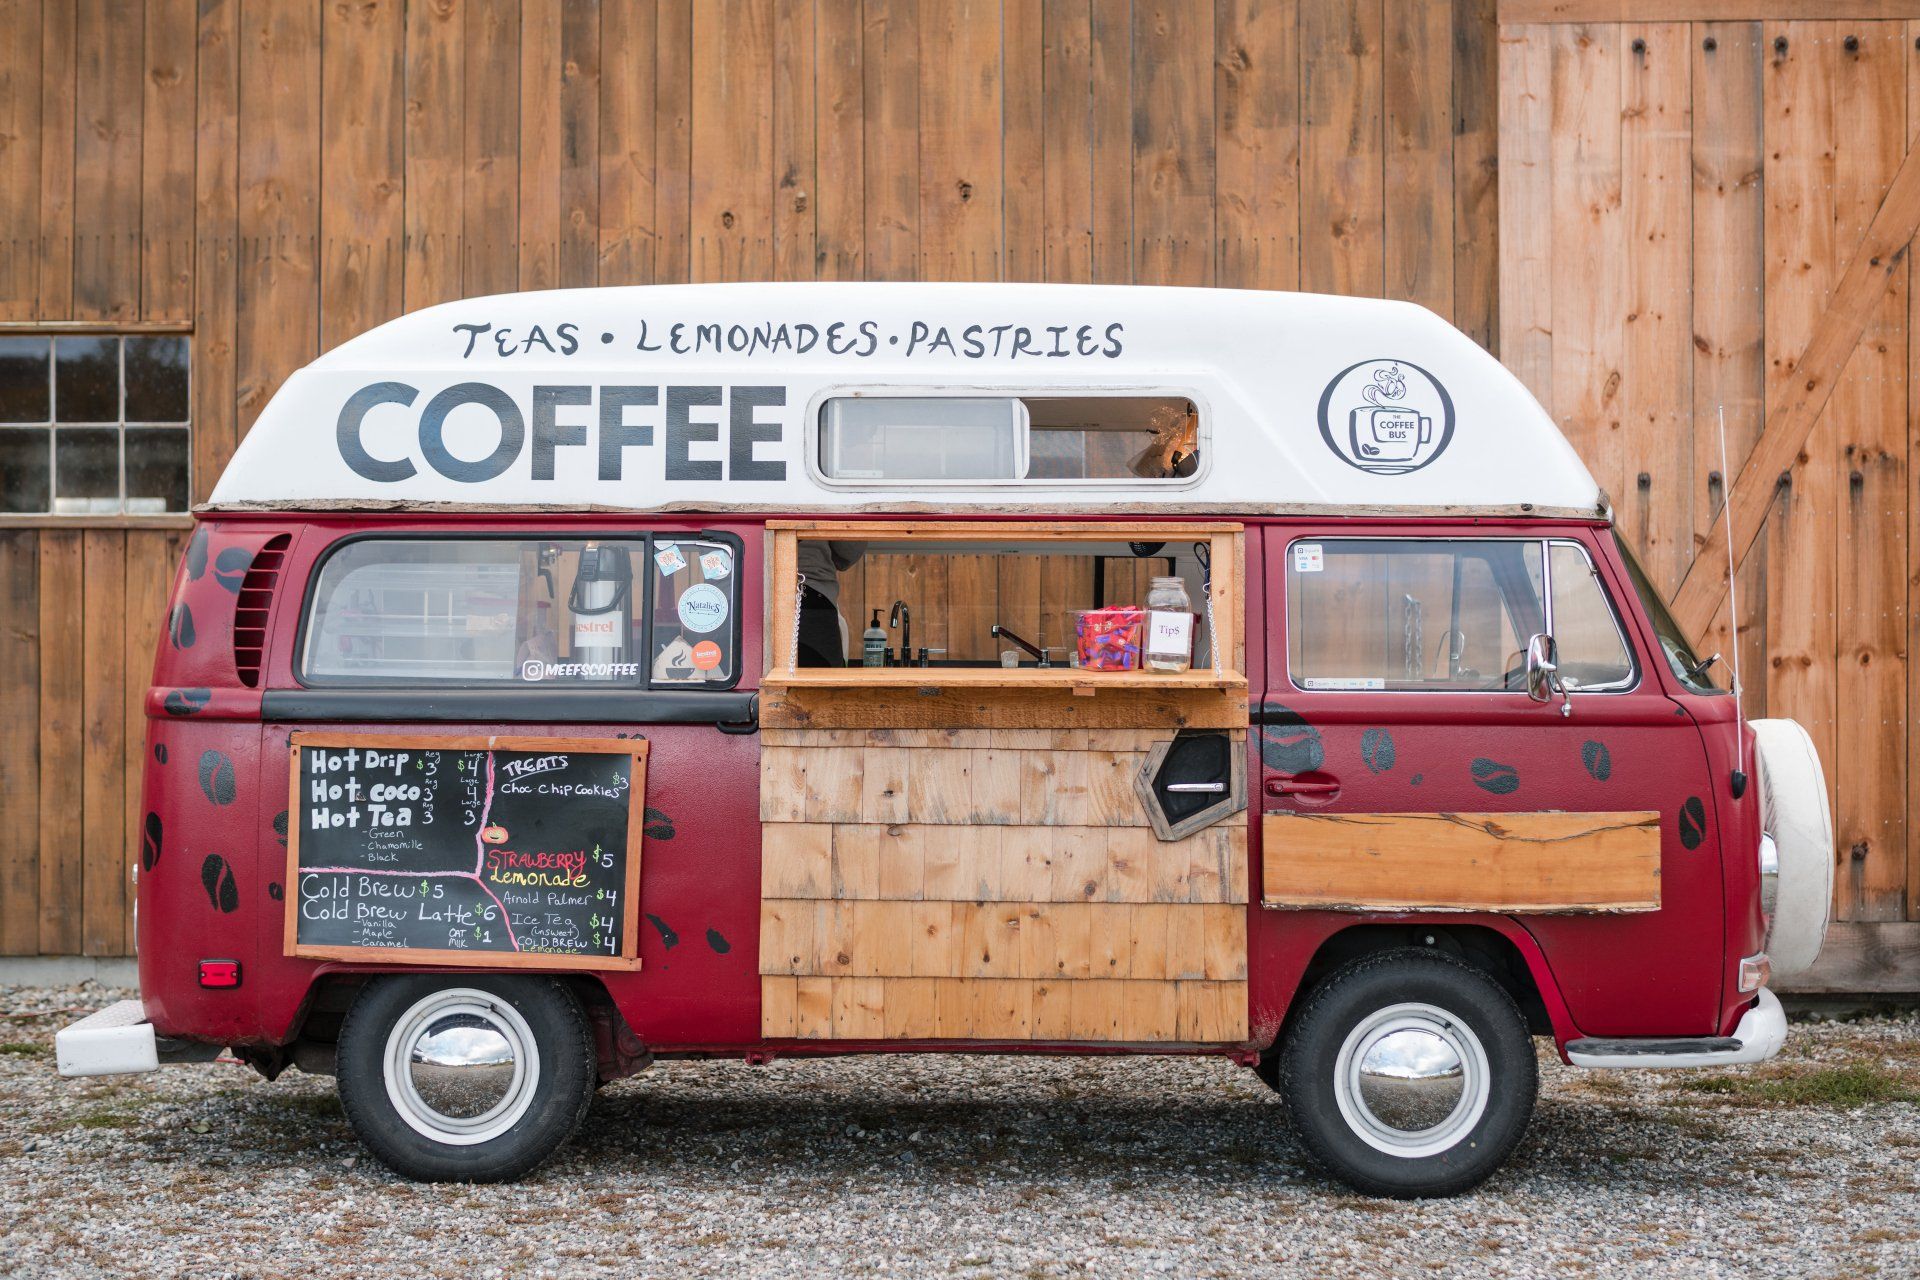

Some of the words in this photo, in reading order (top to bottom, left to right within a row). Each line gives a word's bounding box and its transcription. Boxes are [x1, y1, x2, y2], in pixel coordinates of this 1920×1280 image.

[452, 322, 580, 359] TEAS
[636, 319, 879, 358] LEMONADES
[905, 320, 1125, 359] PASTRIES
[336, 381, 787, 483] COFFEE
[1379, 421, 1415, 429] COFFEE
[1388, 431, 1407, 439] BUS
[545, 663, 639, 677] MEEFSCOFFEE
[311, 748, 360, 774] Hot
[364, 750, 410, 777] Drip
[425, 751, 441, 764] Reg
[464, 751, 485, 763] Large
[502, 755, 569, 778] TREATS
[425, 778, 438, 790] Reg
[460, 777, 480, 785] Large
[311, 776, 362, 803] Hot
[369, 783, 422, 802] coco
[423, 788, 434, 802] 3
[467, 786, 477, 801] 4
[575, 784, 620, 799] Cookies
[461, 800, 481, 808] Large
[311, 806, 361, 829] Hot
[367, 804, 412, 827] Tea
[422, 811, 434, 825] 3
[463, 809, 476, 826] 3
[369, 828, 405, 839] Green
[368, 852, 399, 862] Black
[487, 850, 587, 880] STRAWBERRY
[490, 866, 591, 888] Lemonade
[301, 874, 349, 899] Cold
[358, 876, 416, 898] Brew
[503, 891, 540, 905] Arnold
[547, 892, 593, 906] Palmer
[302, 899, 349, 920] Cold
[357, 902, 408, 920] Brew
[418, 903, 477, 926] Latte
[511, 913, 540, 925] Ice
[544, 913, 577, 926] Tea
[361, 919, 397, 929] Vanilla
[362, 928, 394, 939] Maple
[448, 928, 467, 938] OAT
[361, 937, 410, 948] Caramel
[517, 936, 550, 947] COLD
[552, 937, 588, 949] BREW
[522, 944, 582, 955] Lemonade
